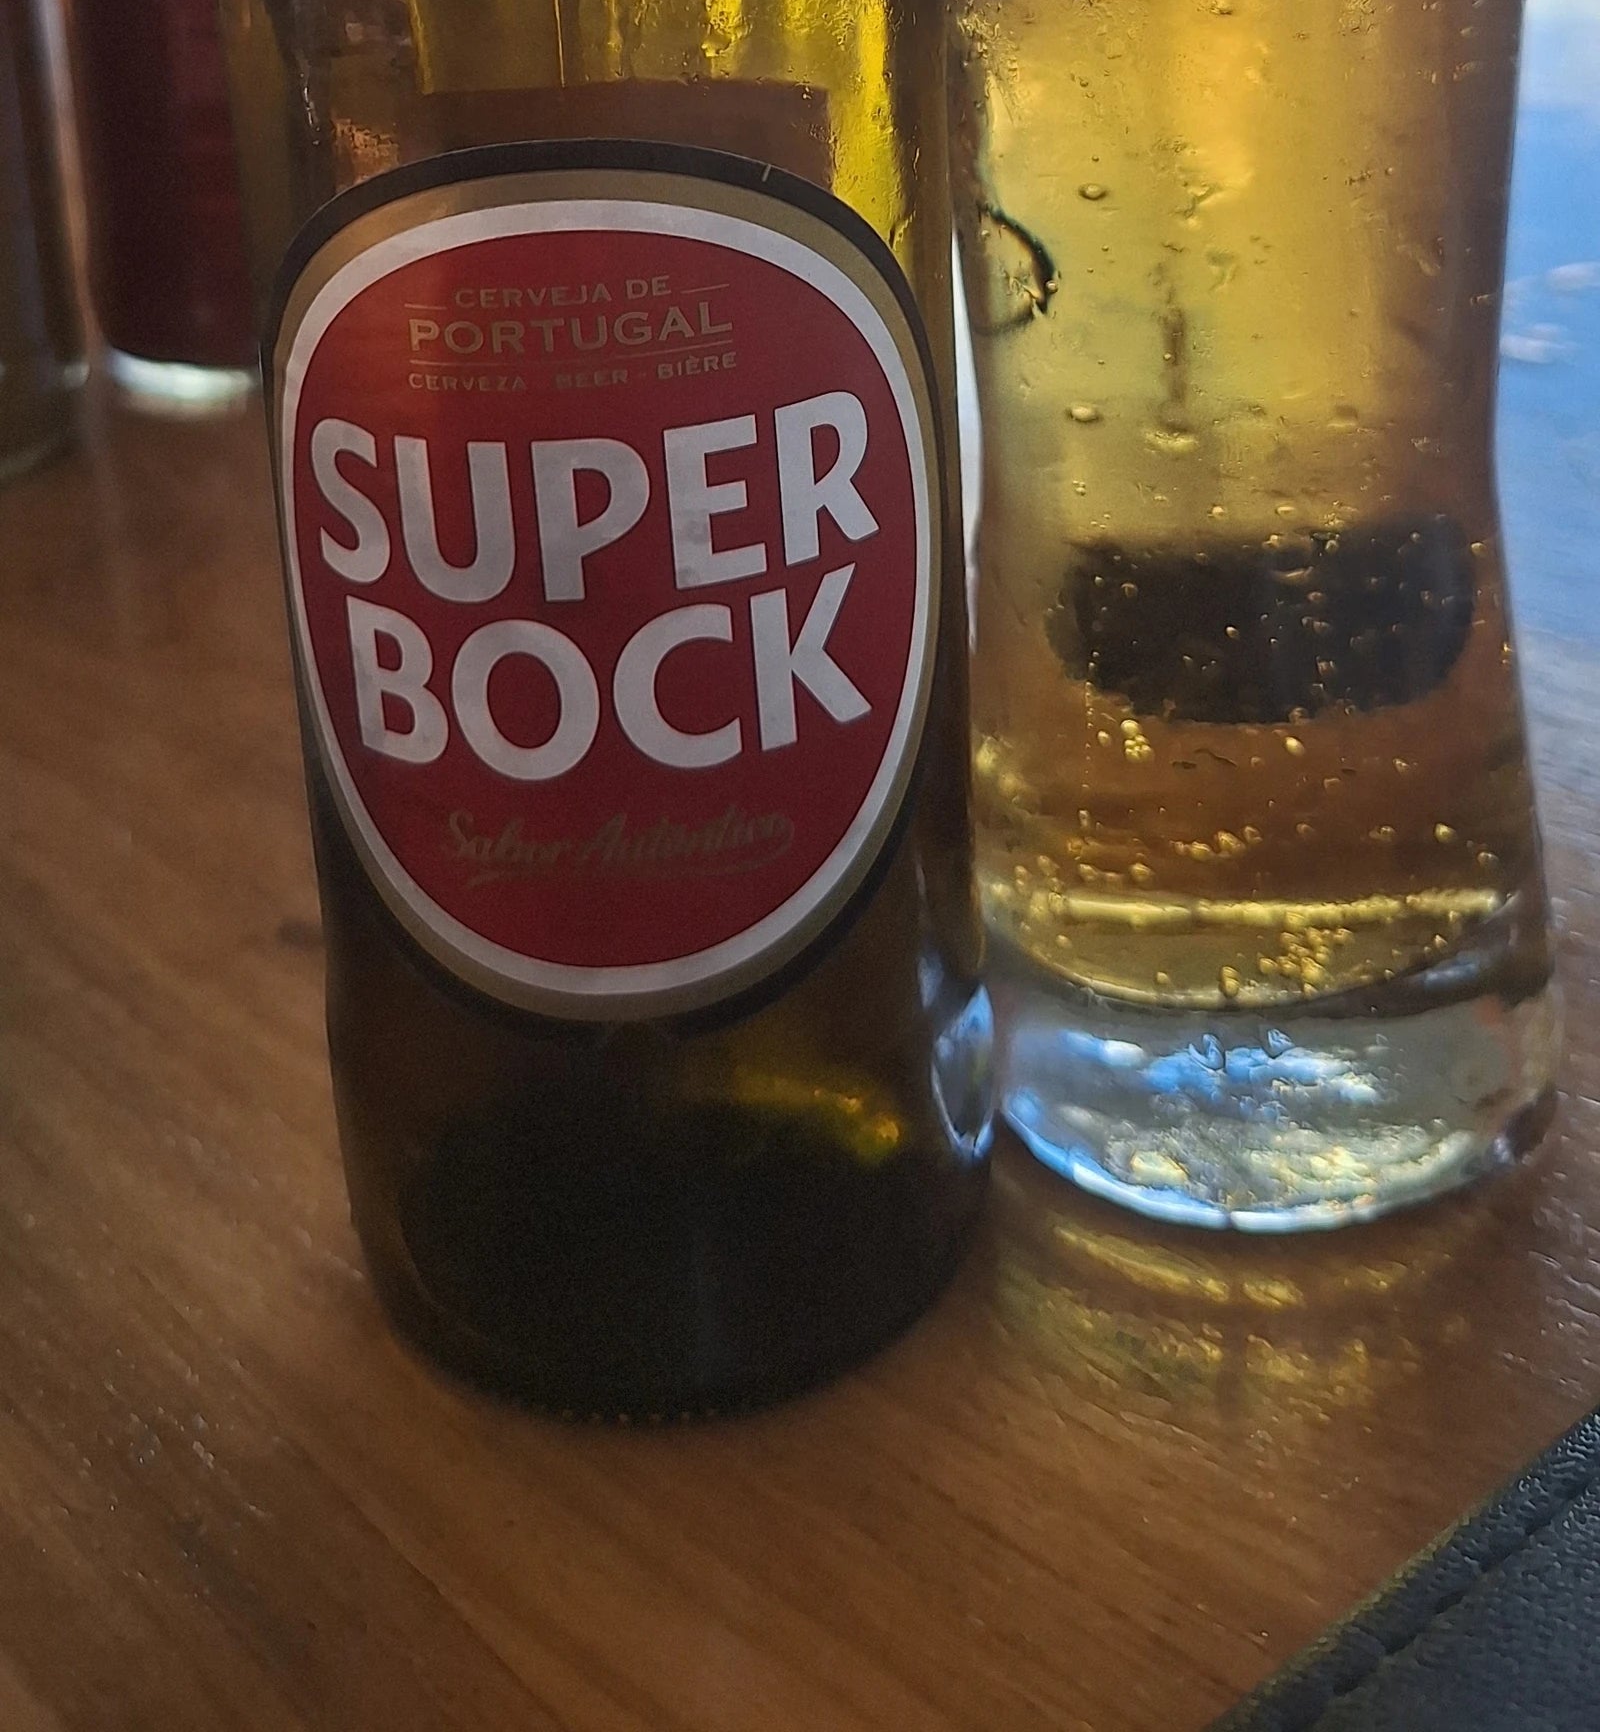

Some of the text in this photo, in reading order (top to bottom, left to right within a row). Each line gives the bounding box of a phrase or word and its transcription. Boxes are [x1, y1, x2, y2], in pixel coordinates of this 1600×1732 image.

[454, 274, 672, 310] CERVEJA DE
[408, 301, 733, 355] PORTUGAL
[408, 351, 737, 392] CERVEZA BEER BIÈRE
[311, 389, 880, 604] SUPER
[345, 562, 872, 781] BOCK
